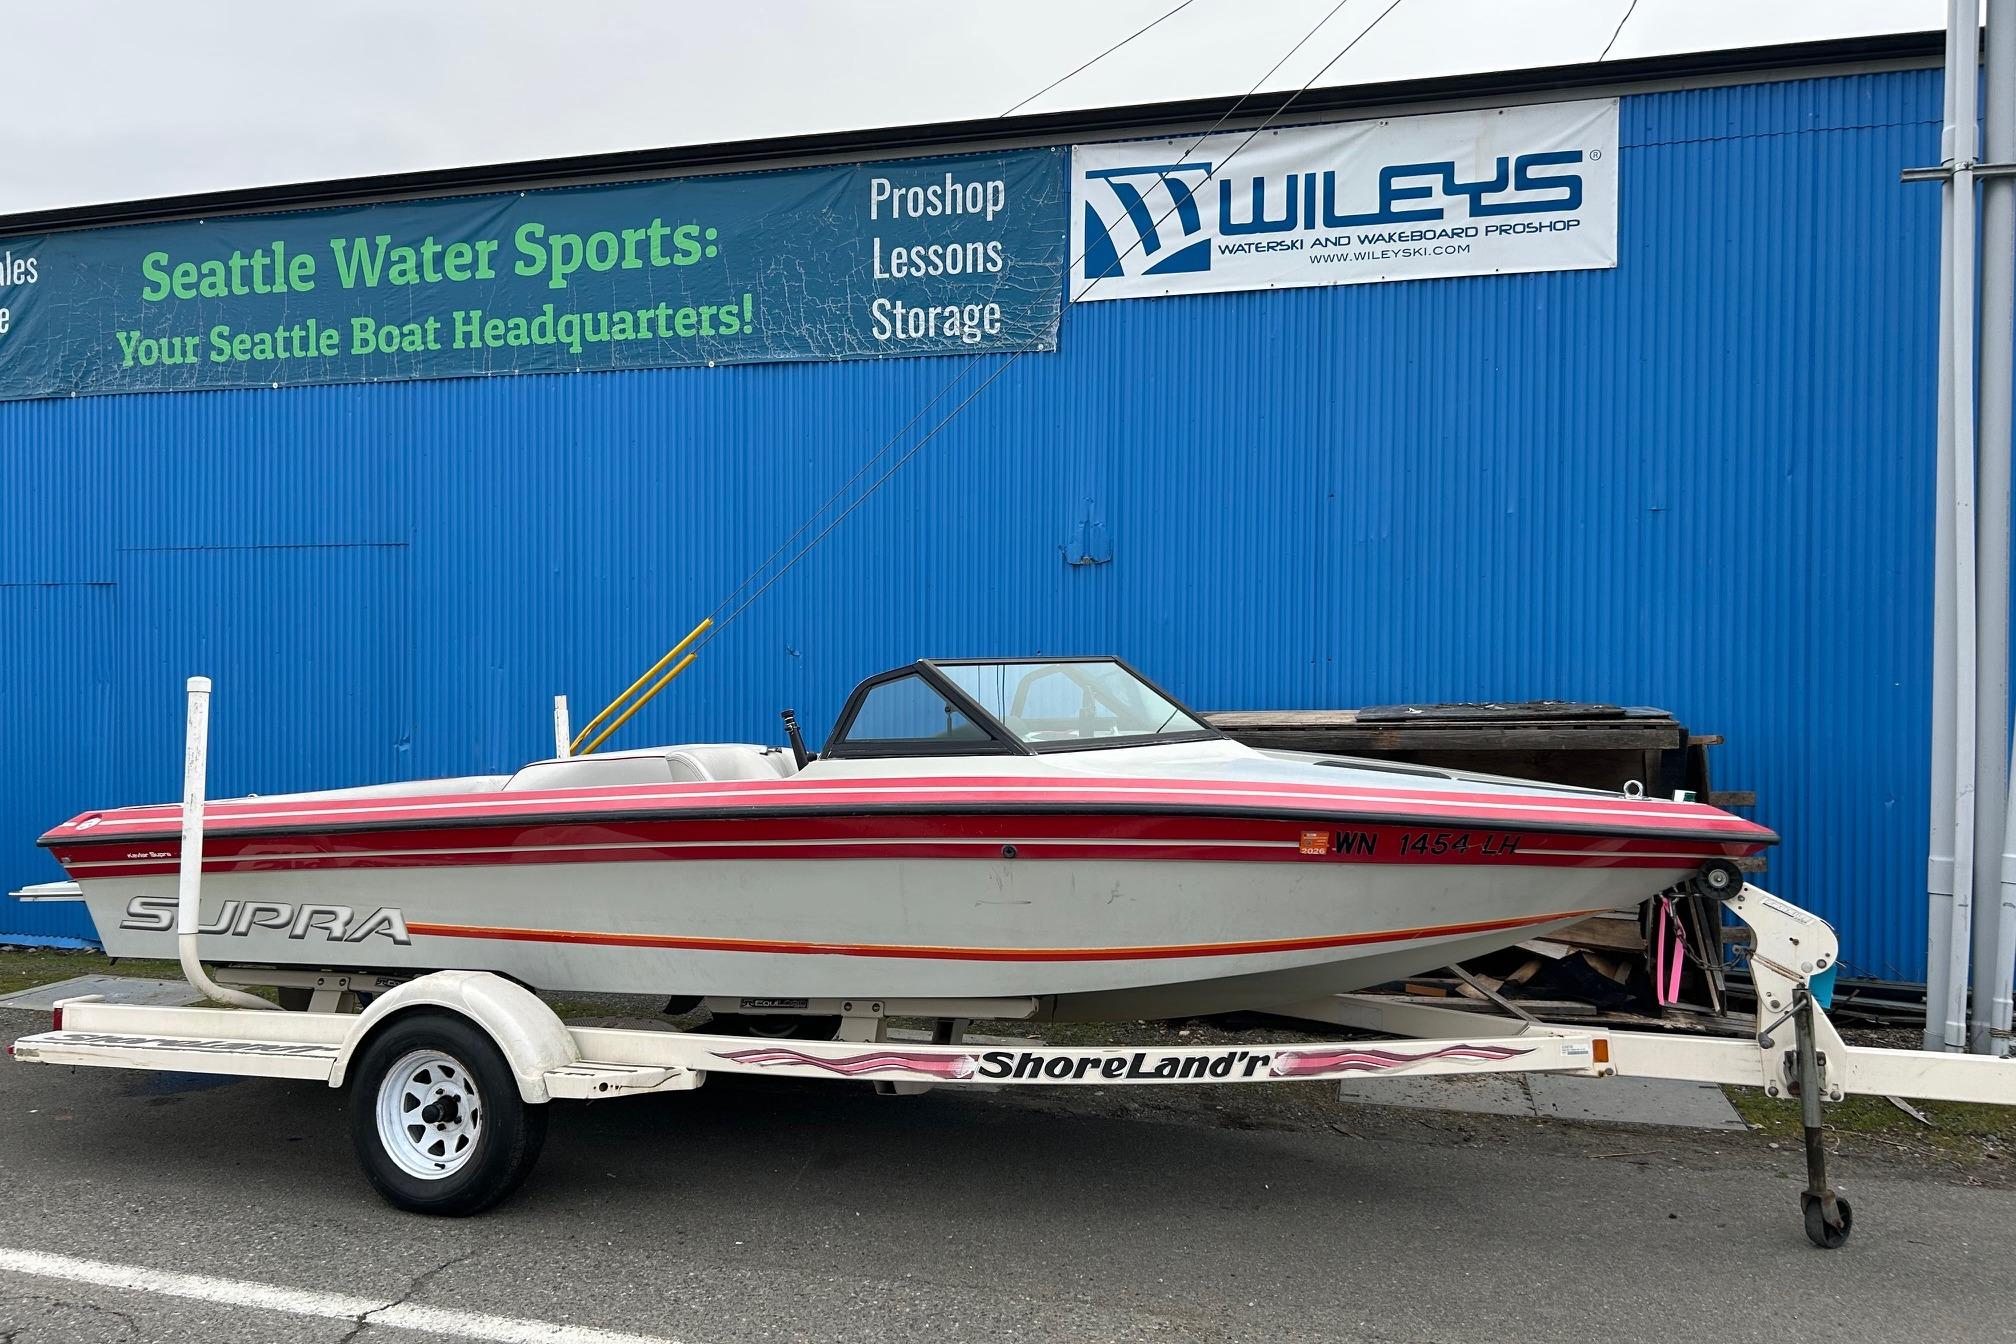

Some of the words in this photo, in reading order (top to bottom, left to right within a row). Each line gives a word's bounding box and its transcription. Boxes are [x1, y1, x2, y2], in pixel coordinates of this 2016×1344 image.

[870, 173, 1005, 221] Proshop
[1219, 150, 1583, 236] WILEYS
[873, 237, 1003, 279] Lessons
[1217, 239, 1304, 255] WATERSKI
[1310, 235, 1351, 249] AND
[1358, 225, 1479, 245] WAKEBOARD
[1484, 219, 1581, 237] PROSHOP
[1309, 244, 1470, 264] WWW.WILEYSKI.COM
[142, 241, 315, 301] Seattle
[331, 236, 498, 289] Water
[515, 219, 717, 289] Sports:
[117, 331, 199, 368] Your
[210, 319, 339, 362] Seattle
[352, 317, 440, 355] Boat
[454, 295, 752, 354] Headquarters!
[872, 298, 1001, 344] Storage
[1300, 847, 1326, 855] 2026
[1335, 831, 1378, 855] WN
[1400, 832, 1470, 855] 1454
[1480, 834, 1521, 855] LH
[119, 895, 413, 946] SUPRA
[978, 1051, 1271, 1081] ShoreLand'r
